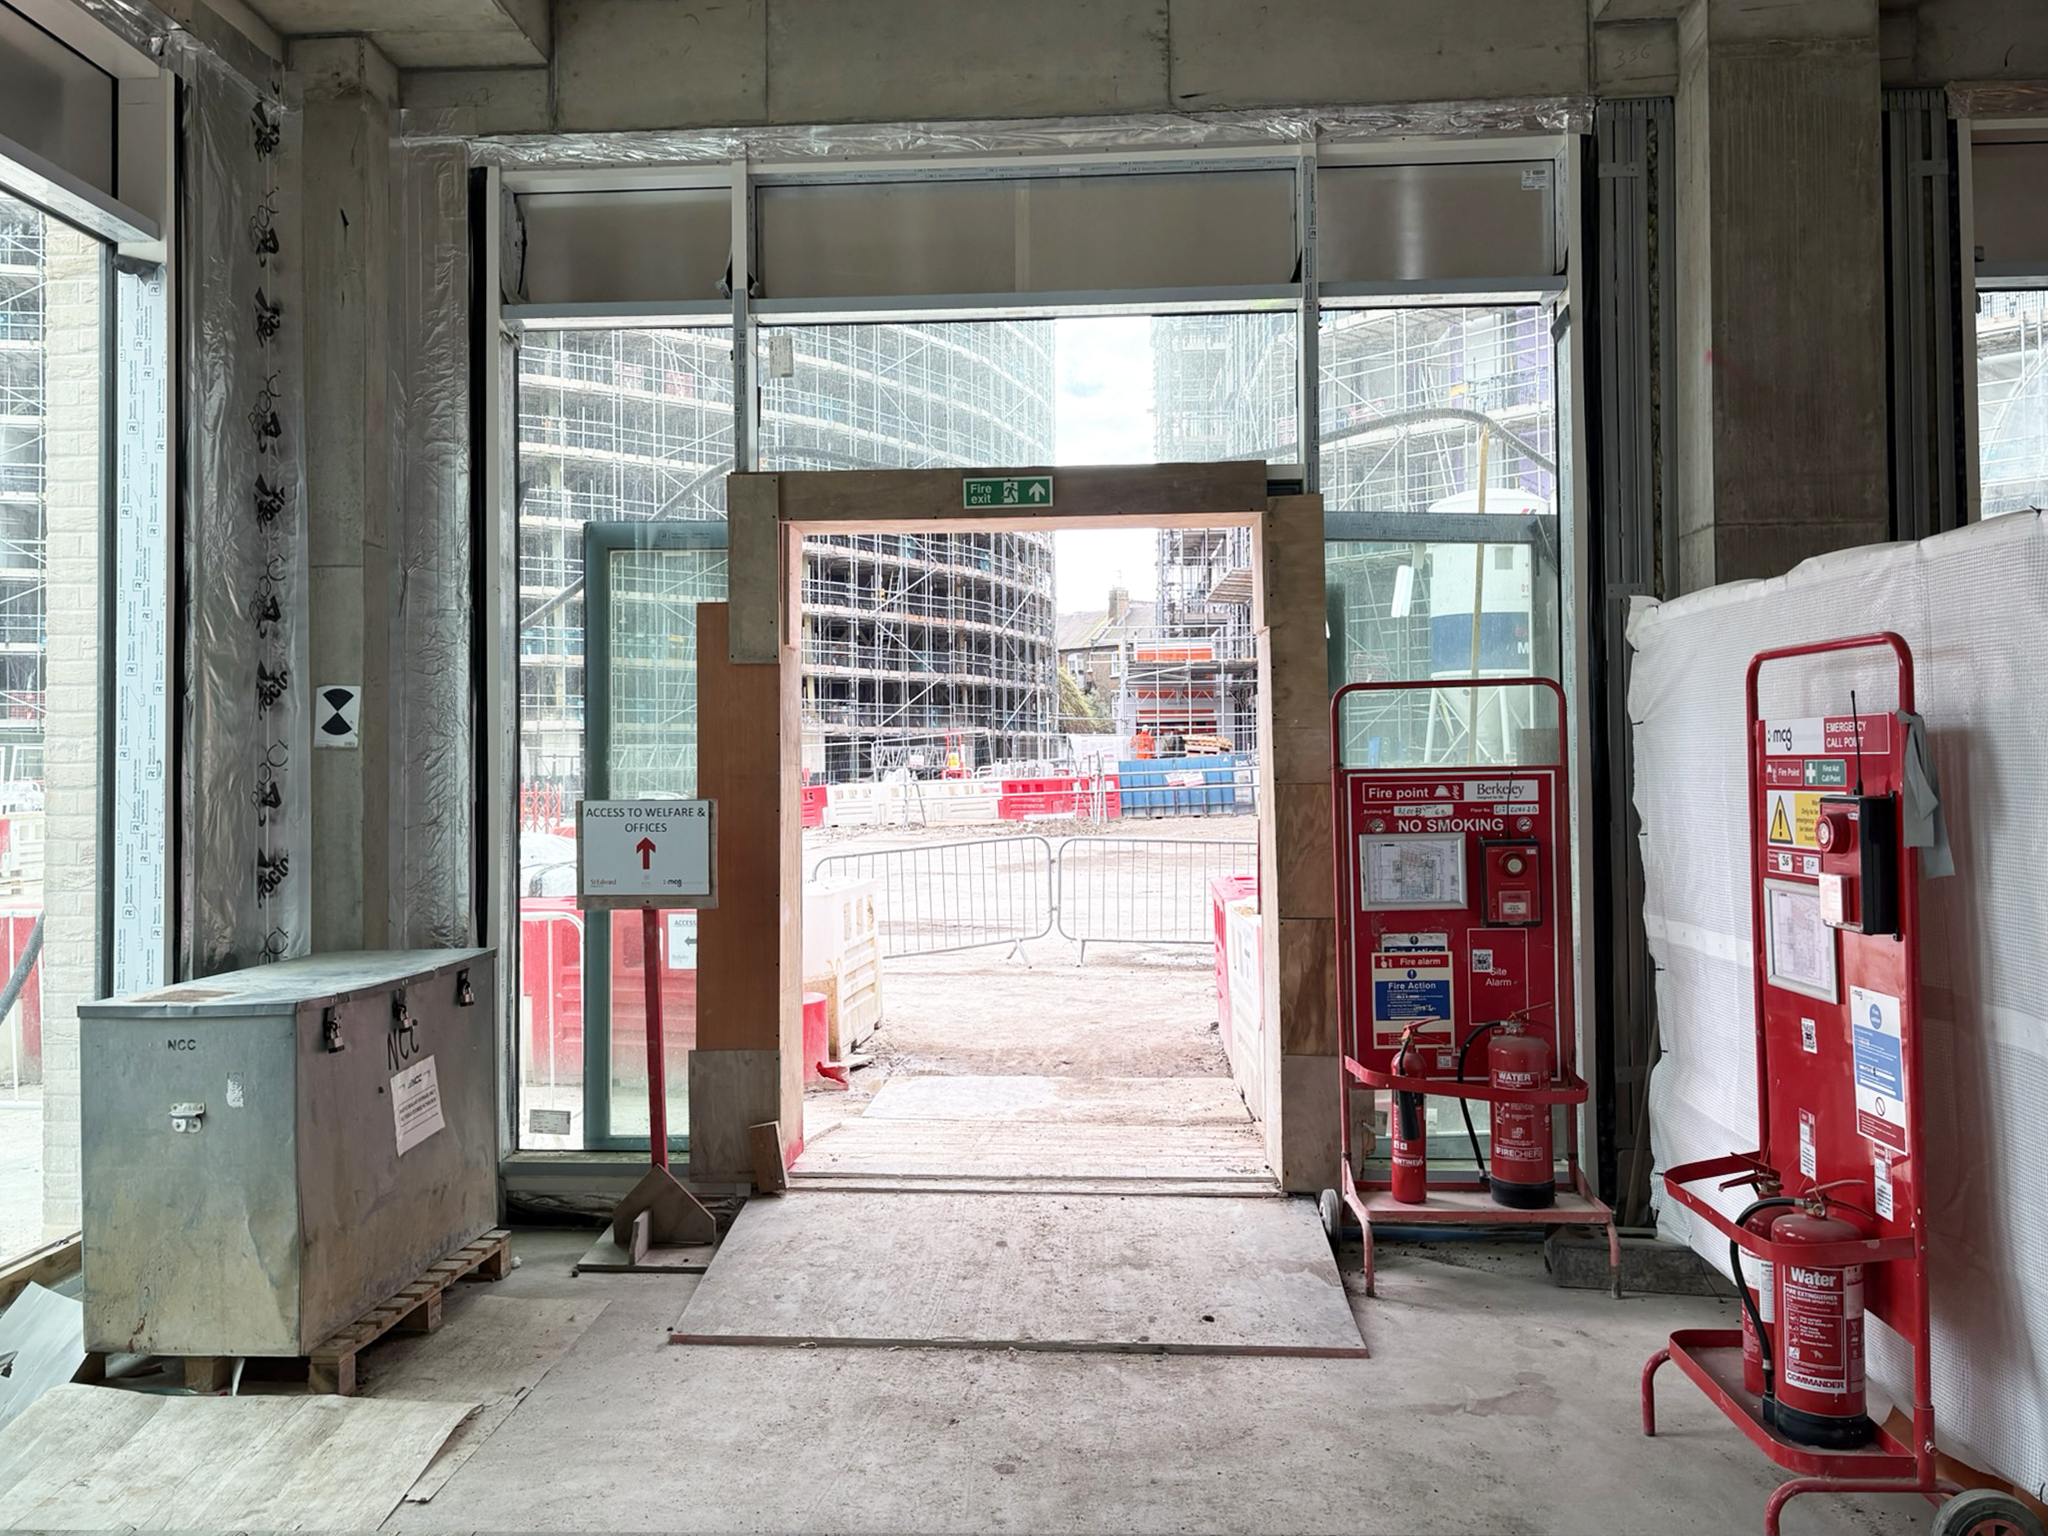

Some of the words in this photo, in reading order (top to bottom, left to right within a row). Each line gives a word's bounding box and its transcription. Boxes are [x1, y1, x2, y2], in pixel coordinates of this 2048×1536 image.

[971, 484, 992, 493] Fire
[971, 494, 991, 504] exit
[1773, 728, 1792, 751] mcg
[1826, 737, 1843, 748] CALL
[1369, 788, 1392, 798] Fire
[1396, 788, 1429, 800] point
[1477, 783, 1524, 799] Berkeley
[586, 808, 624, 817] ACCESS
[628, 808, 643, 817] TO
[646, 807, 693, 817] WELFARE
[697, 808, 706, 817] &
[625, 823, 667, 832] OFFICES
[1398, 820, 1422, 832] NO
[1427, 818, 1504, 832] SMOKING
[668, 879, 682, 887] mcg
[1485, 977, 1512, 987] Alarm
[168, 1040, 196, 1050] NCC
[387, 1028, 419, 1070] NCC
[1498, 1072, 1531, 1081] WATER
[1791, 1267, 1836, 1287] Water
[1797, 1290, 1838, 1300] EXTINGUISHER
[1787, 1373, 1844, 1389] COMMANDER
